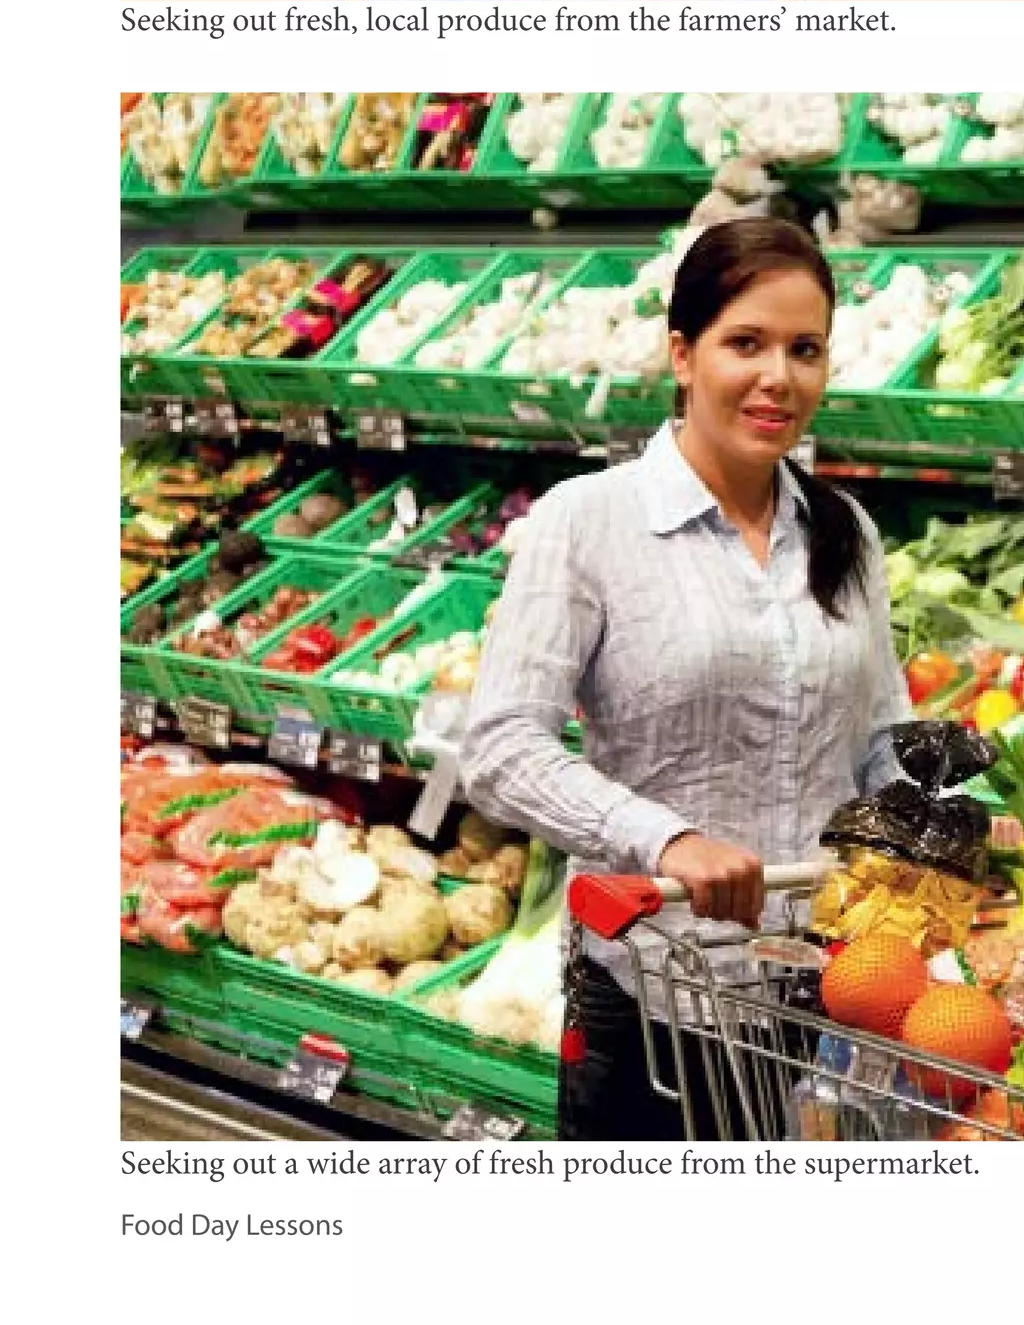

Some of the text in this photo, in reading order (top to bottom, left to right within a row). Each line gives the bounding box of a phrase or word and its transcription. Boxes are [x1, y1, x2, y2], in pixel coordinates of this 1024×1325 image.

[122, 6, 895, 39] Seeking out fresh, local produce from the farmers’ market.
[122, 1150, 978, 1182] Seeking out a wide array of fresh produce from the supermarket.
[123, 1213, 342, 1241] Food Day Lessons
